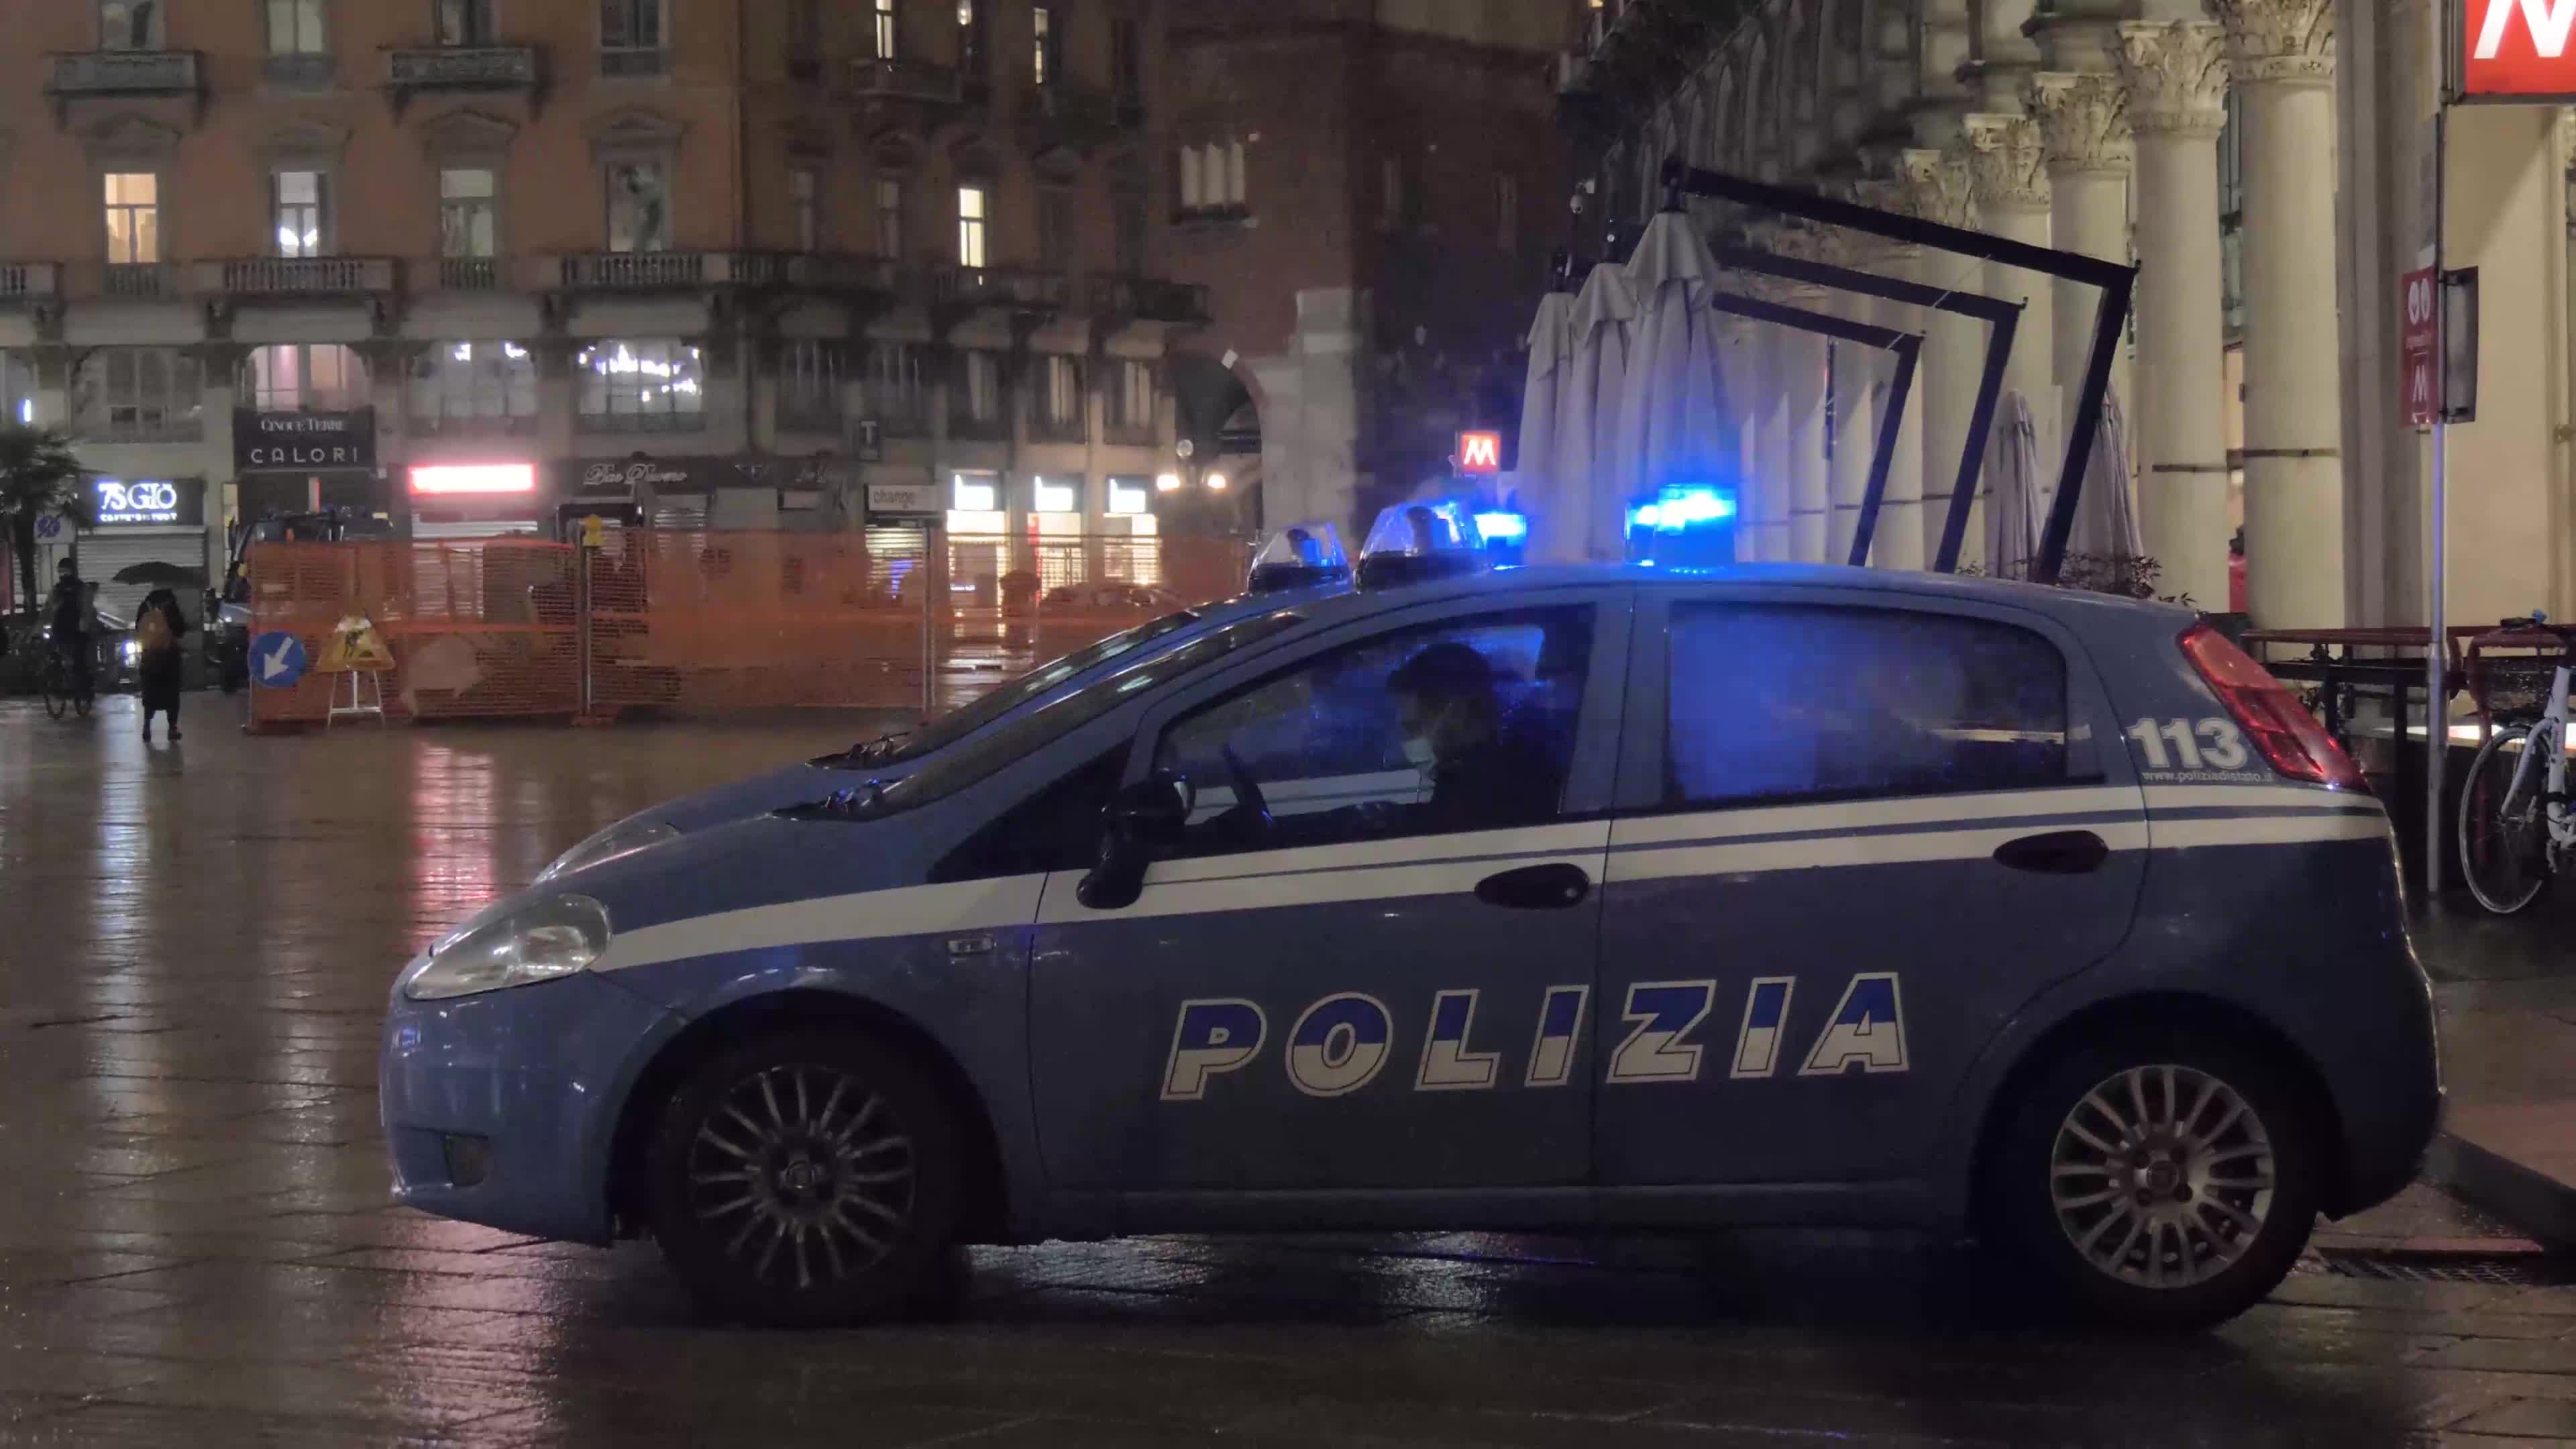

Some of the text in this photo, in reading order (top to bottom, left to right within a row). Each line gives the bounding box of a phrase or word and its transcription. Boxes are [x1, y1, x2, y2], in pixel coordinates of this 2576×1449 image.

[250, 447, 358, 464] CALORI
[1464, 439, 1496, 465] M
[2125, 717, 2248, 770] 113
[1160, 971, 1910, 1101] POLIZIA
